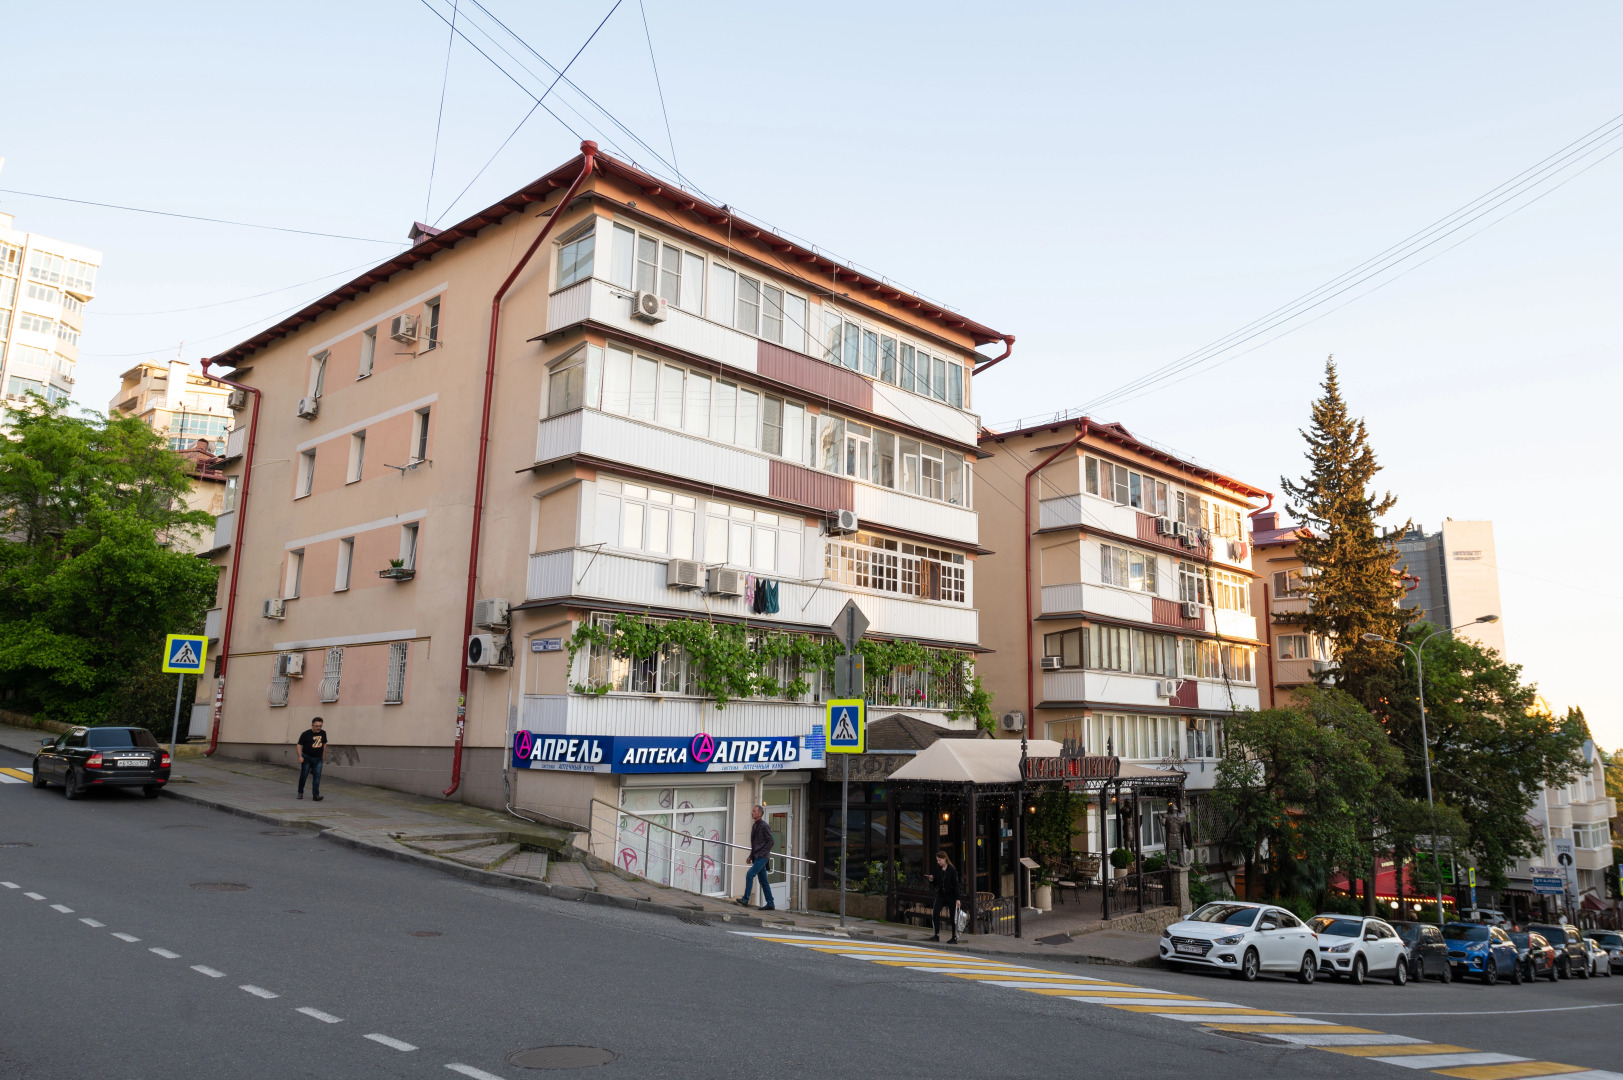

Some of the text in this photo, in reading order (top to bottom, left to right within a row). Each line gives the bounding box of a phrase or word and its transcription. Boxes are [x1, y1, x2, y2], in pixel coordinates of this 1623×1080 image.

[530, 738, 603, 763] АПРЕЛЬ
[623, 748, 687, 763] АПТЕКА
[713, 741, 797, 762] АПРЕЛЬ
